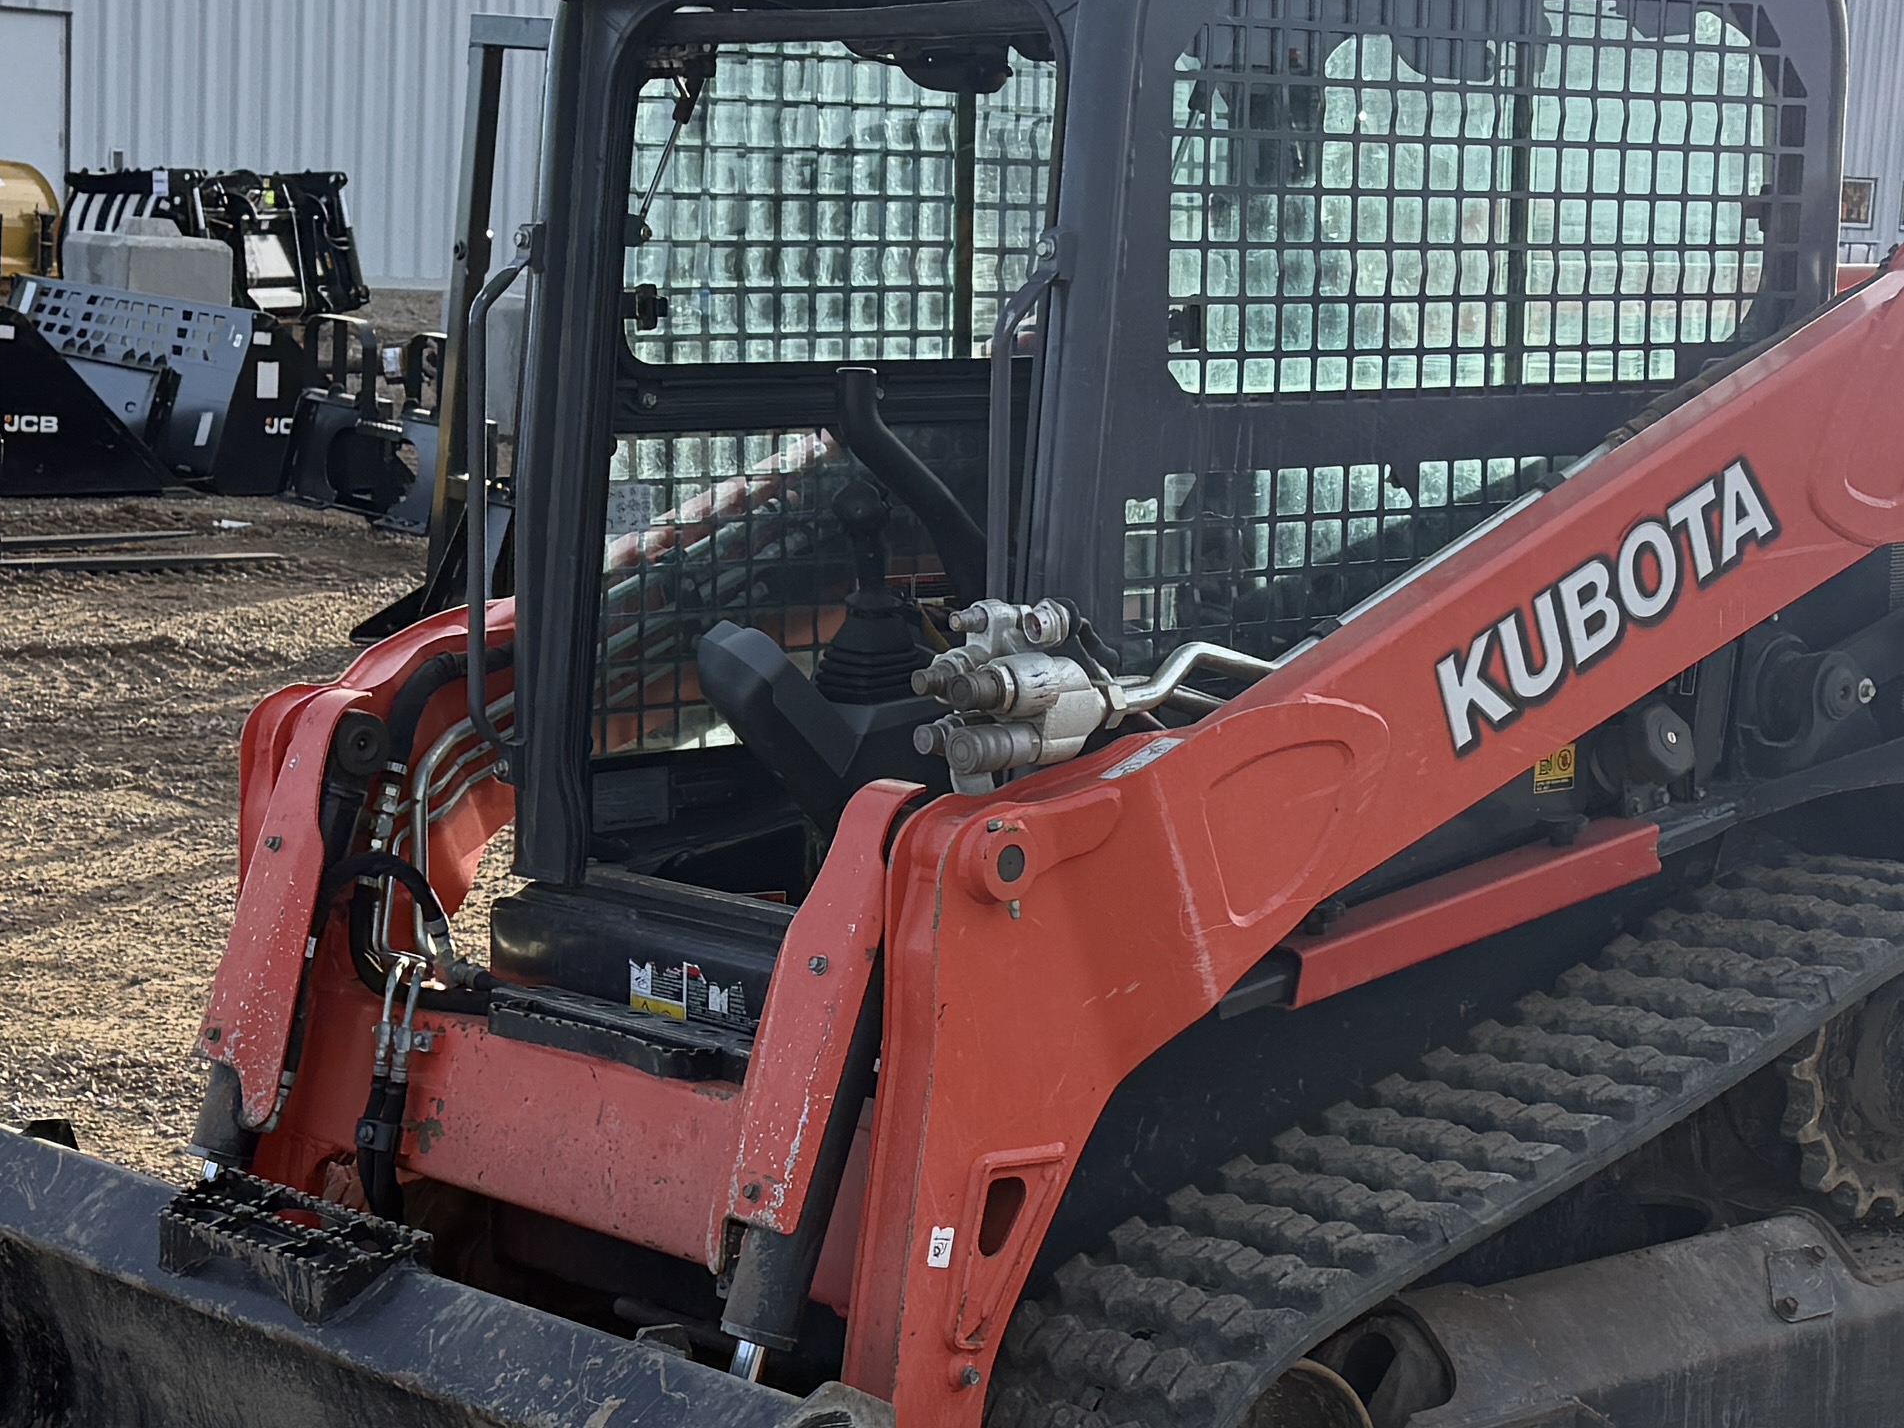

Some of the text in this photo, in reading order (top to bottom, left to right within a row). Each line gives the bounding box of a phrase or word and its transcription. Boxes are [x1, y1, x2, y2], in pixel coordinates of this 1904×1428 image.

[3, 414, 59, 433] JCB
[264, 417, 294, 434] JC
[1434, 459, 1775, 753] KUBOTA
